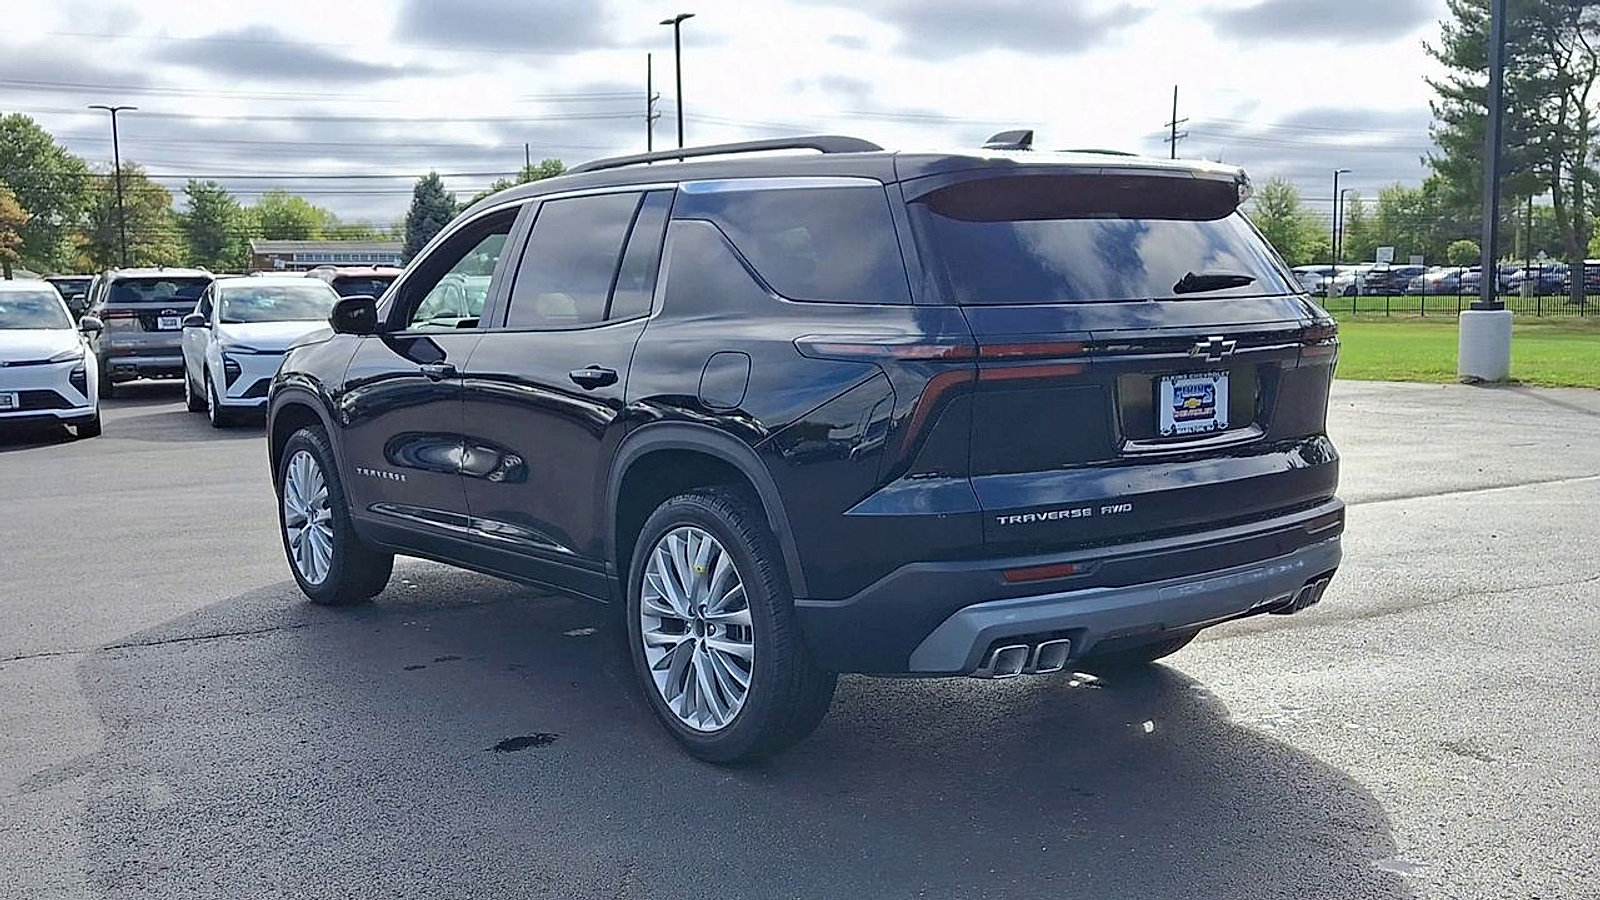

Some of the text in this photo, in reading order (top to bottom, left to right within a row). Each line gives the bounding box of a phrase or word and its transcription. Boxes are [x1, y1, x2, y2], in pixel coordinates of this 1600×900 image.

[1189, 371, 1230, 379] CHEVROLET
[1173, 383, 1213, 405] ELKINS
[1174, 408, 1214, 418] CHEVROLET
[356, 467, 406, 482] TRAVERSE
[997, 503, 1133, 525] TRAVERSE AWD
